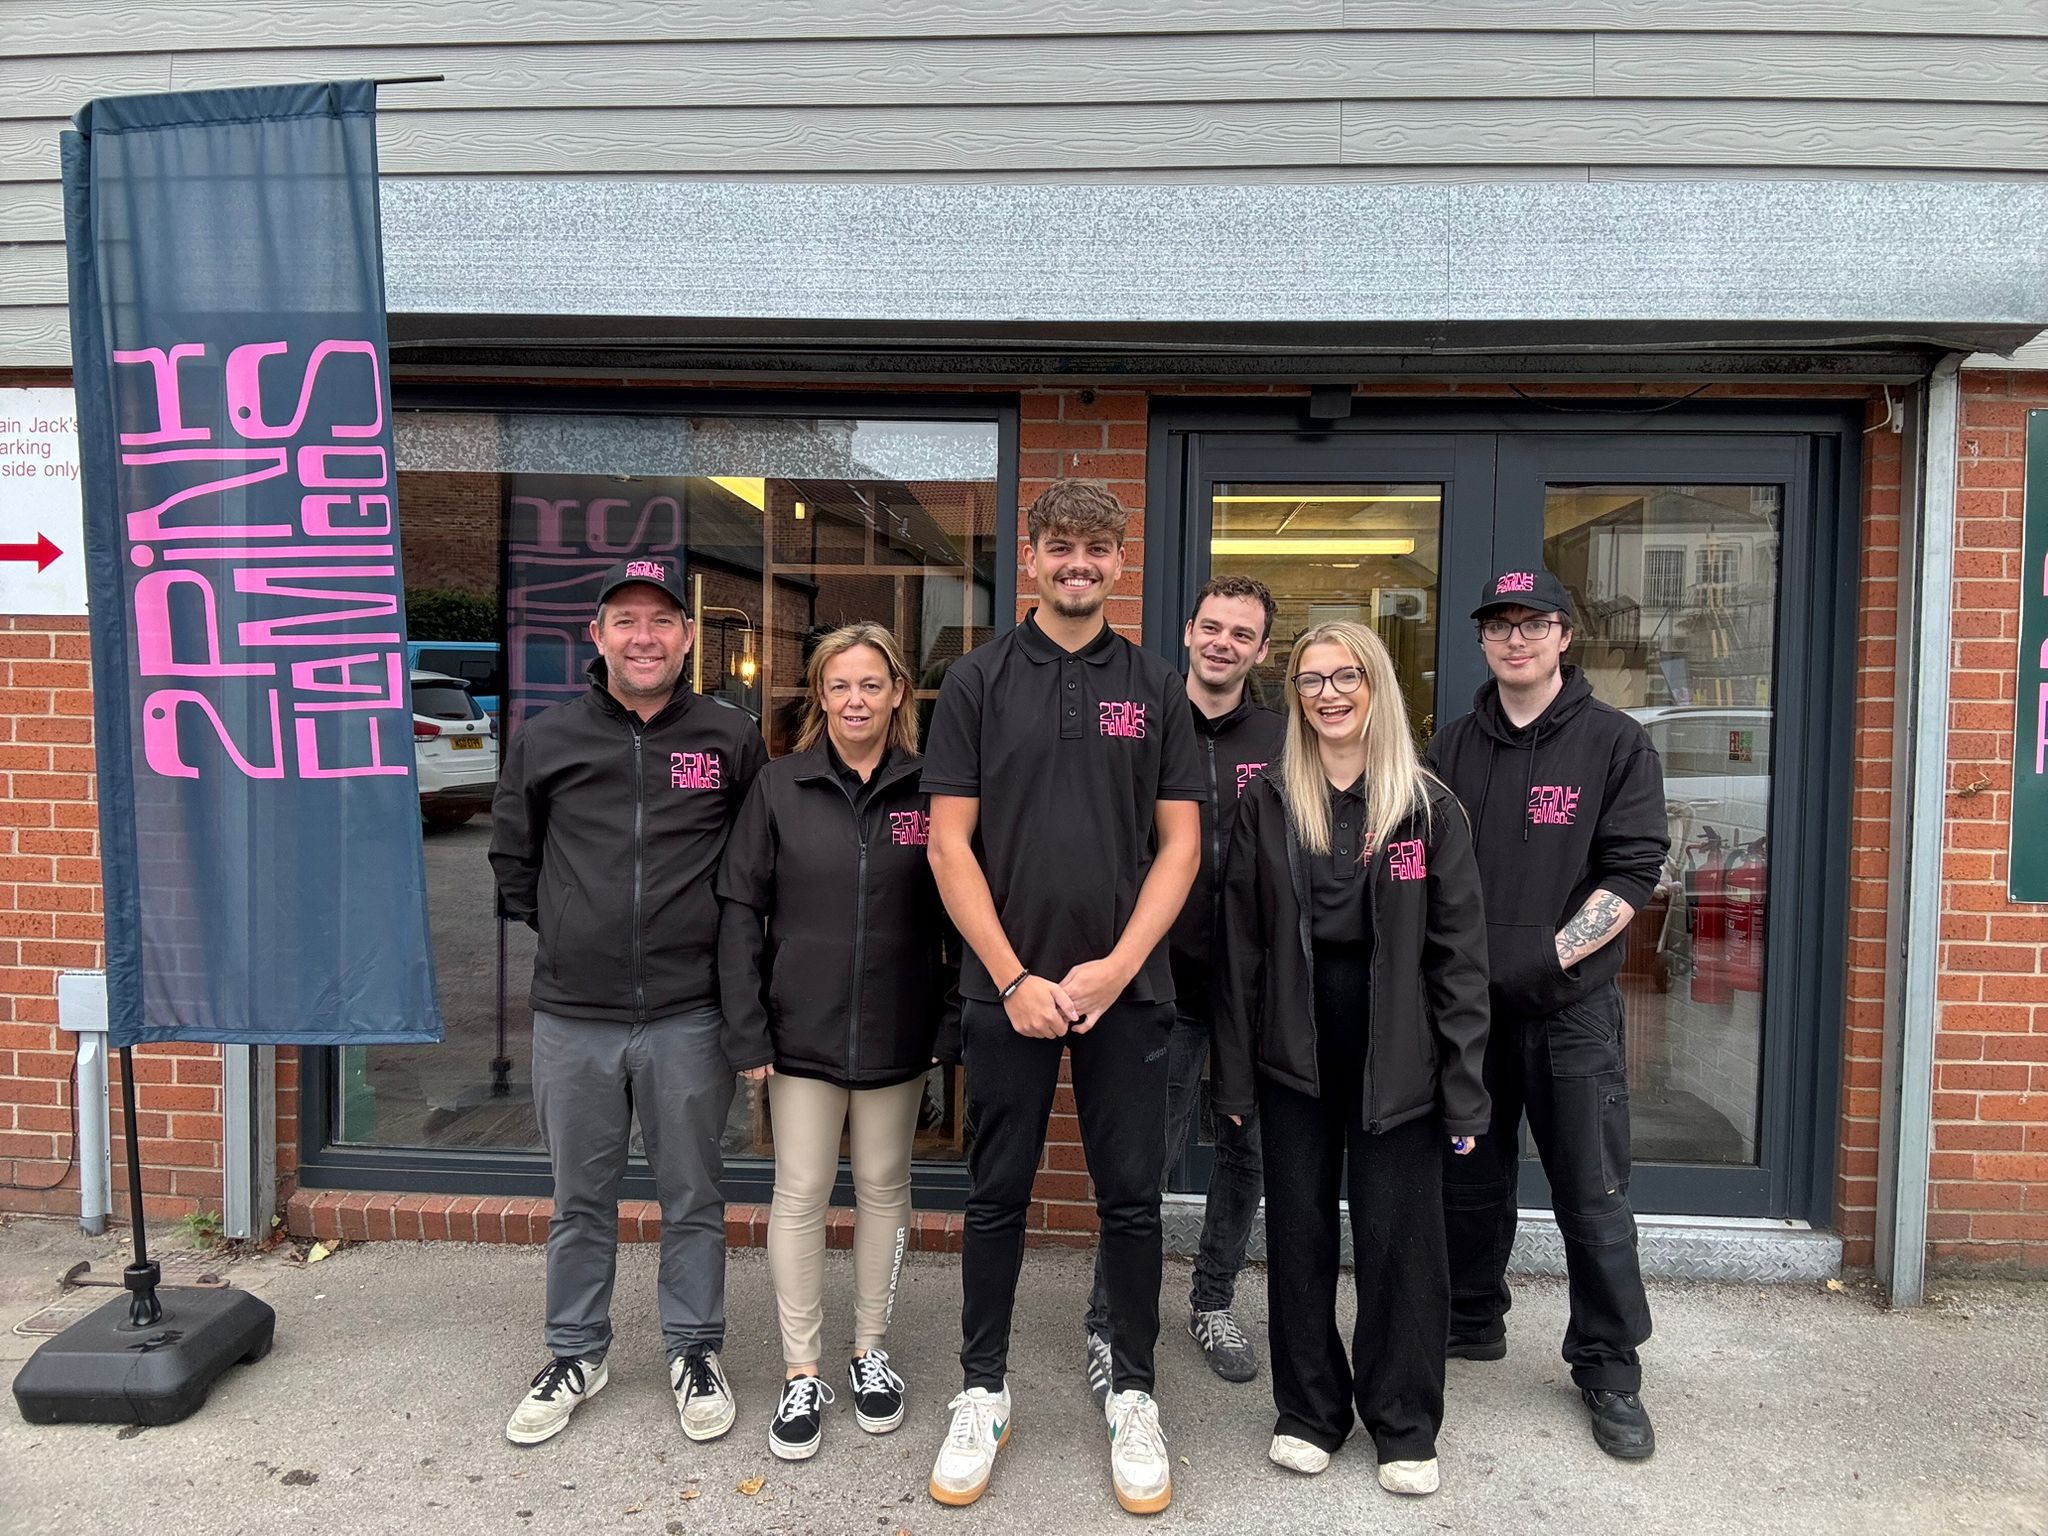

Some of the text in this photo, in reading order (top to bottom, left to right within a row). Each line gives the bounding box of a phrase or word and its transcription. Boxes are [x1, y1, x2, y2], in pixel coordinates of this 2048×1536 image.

[29, 416, 79, 433] Jack's
[2, 460, 80, 481] side only
[889, 1226, 905, 1290] ARMOUR
